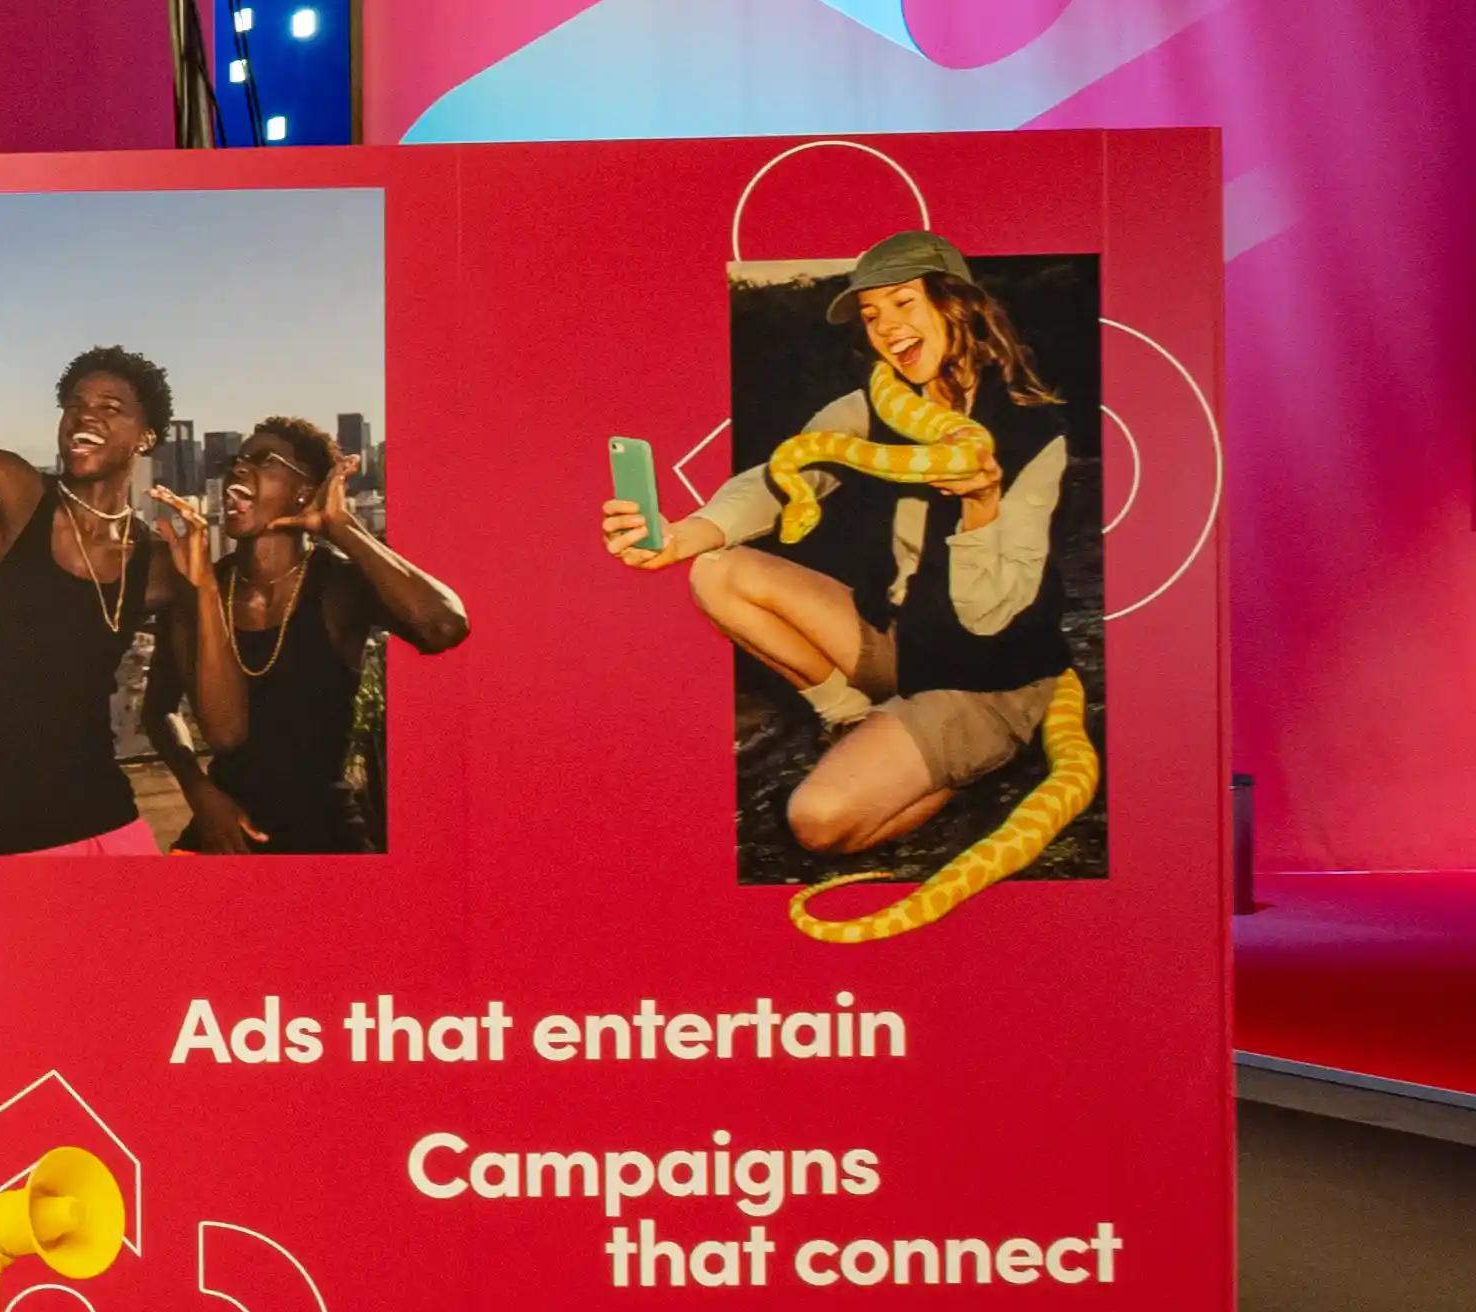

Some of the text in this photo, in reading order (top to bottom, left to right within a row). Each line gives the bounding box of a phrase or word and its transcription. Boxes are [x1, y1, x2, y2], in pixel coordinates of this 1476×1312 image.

[170, 991, 908, 1065] Ads that entertain
[407, 1130, 881, 1217] Campaigns
[605, 1219, 1122, 1287] that connect
